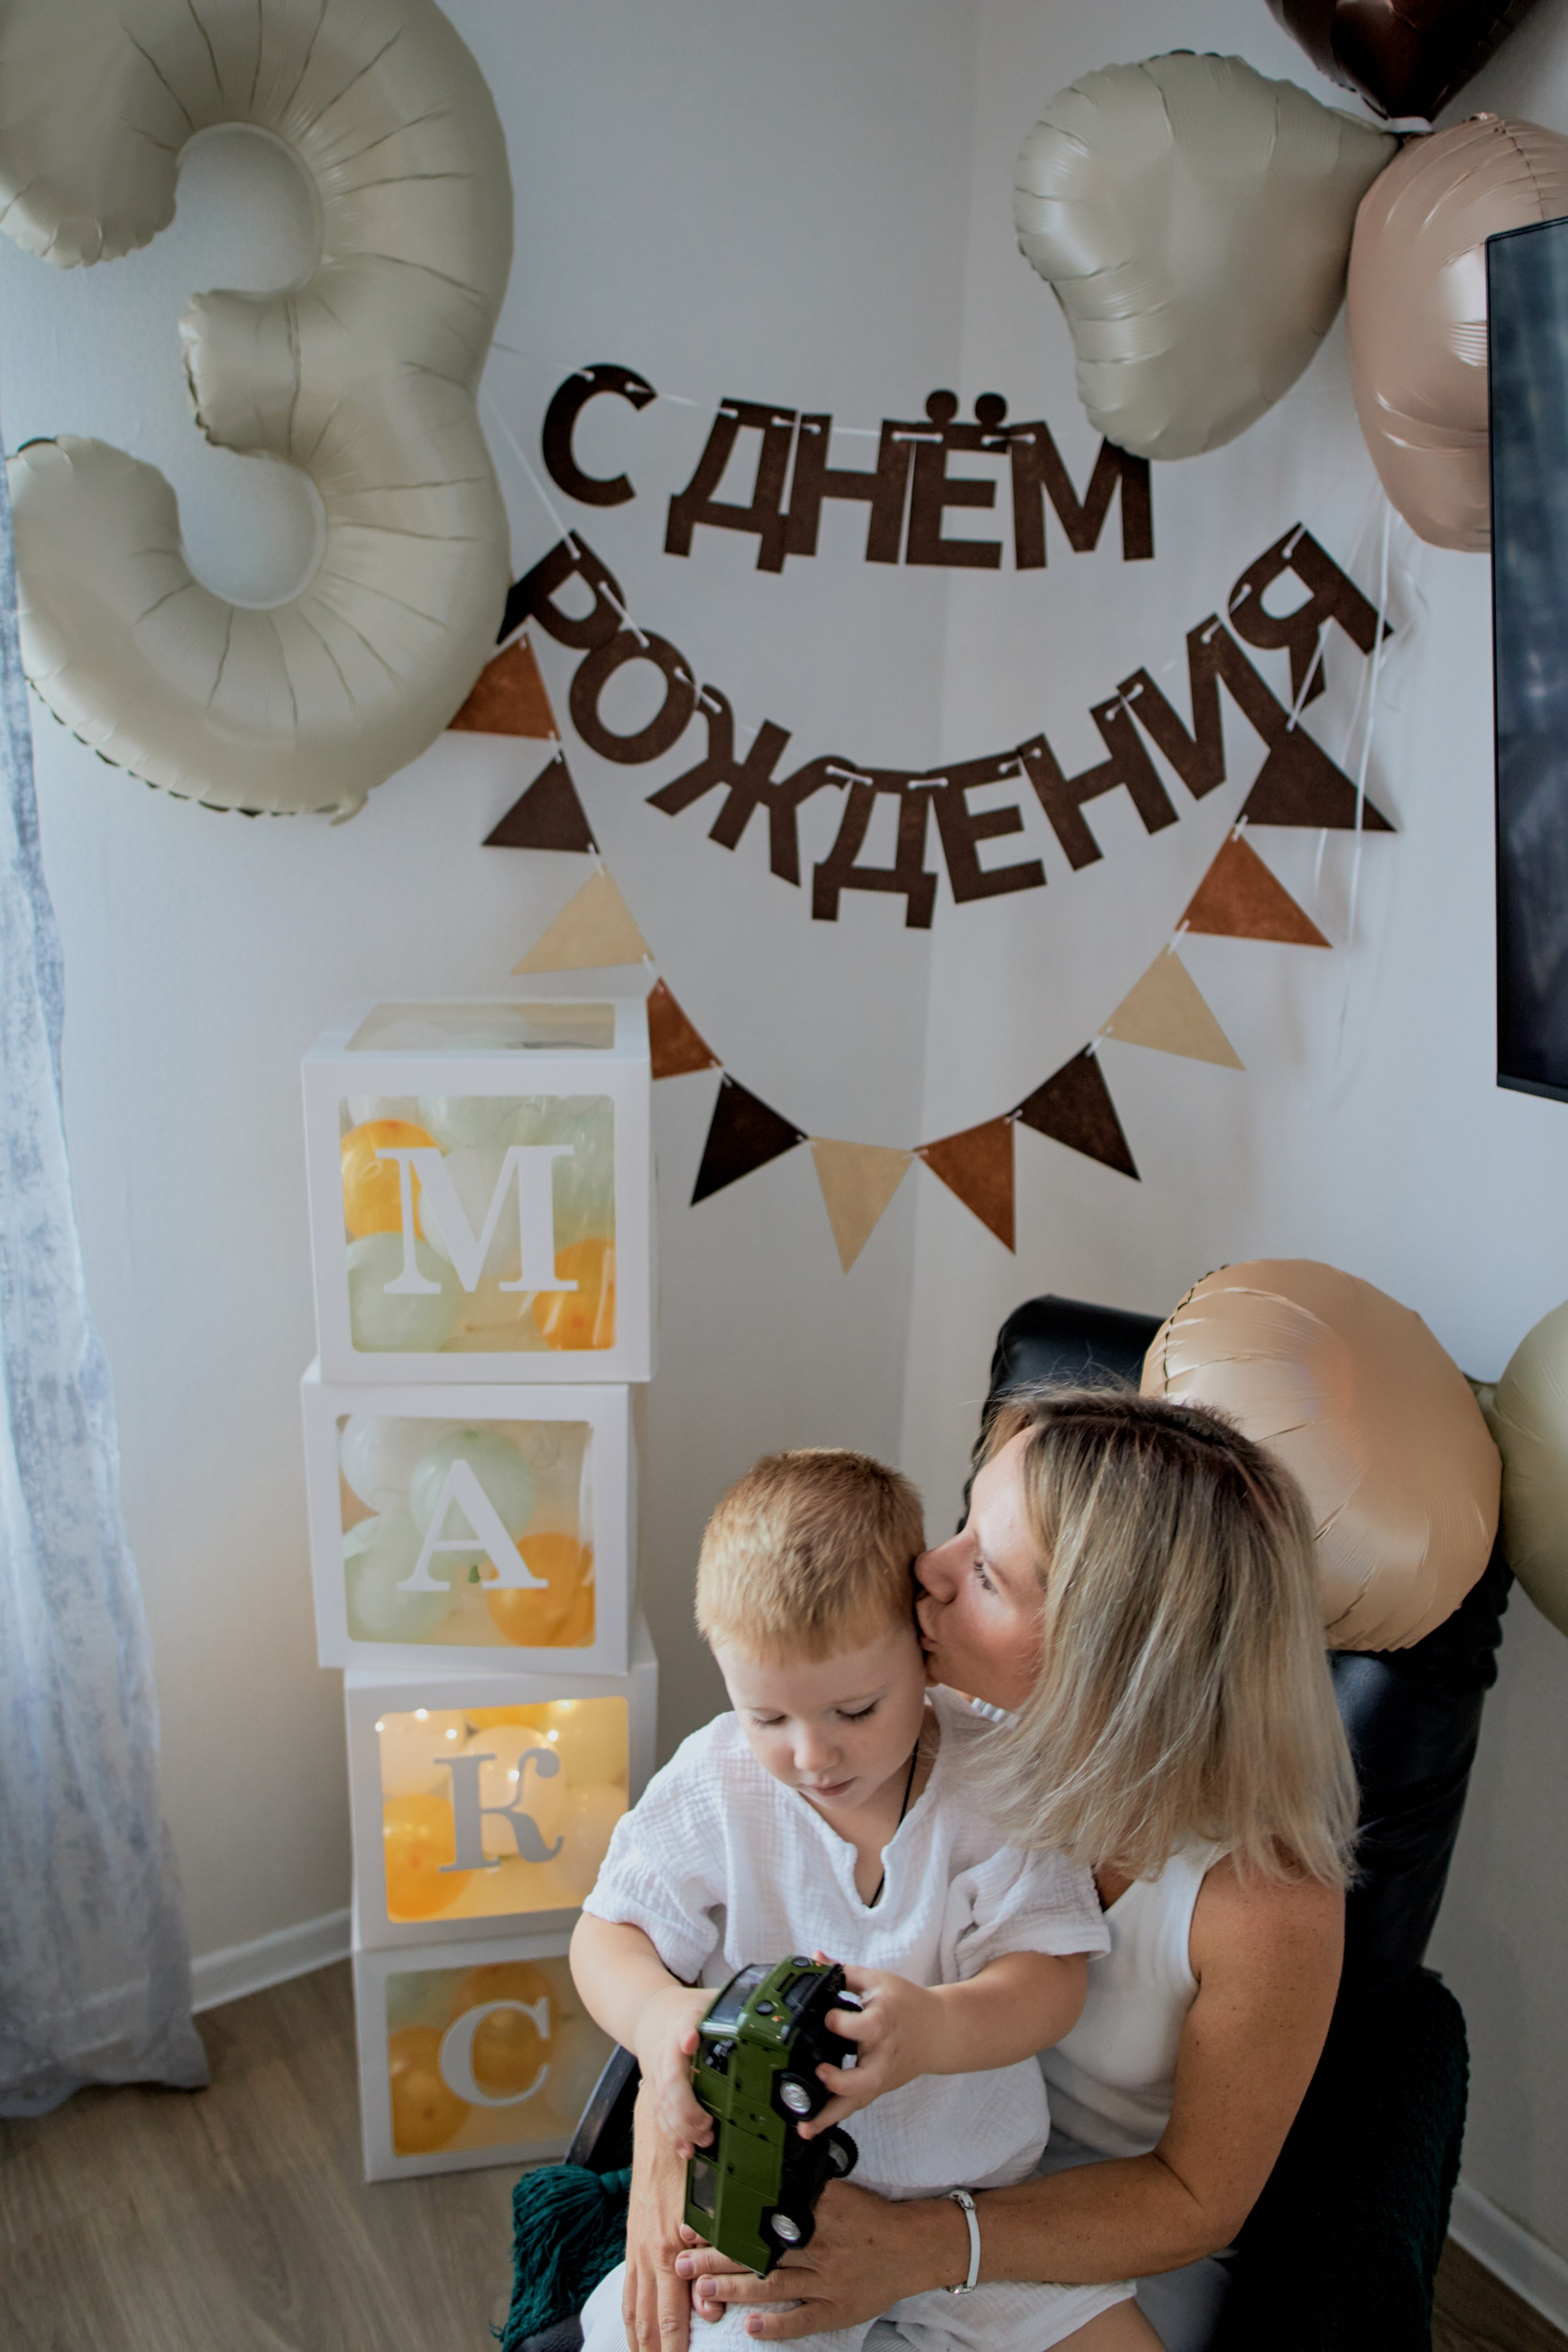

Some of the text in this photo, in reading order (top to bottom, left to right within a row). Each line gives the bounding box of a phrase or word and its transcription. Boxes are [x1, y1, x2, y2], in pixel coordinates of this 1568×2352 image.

[0, 0, 513, 825] 3
[542, 363, 1155, 574] С ДНЁМ
[496, 522, 1395, 930] РОЖДЕНИЯ
